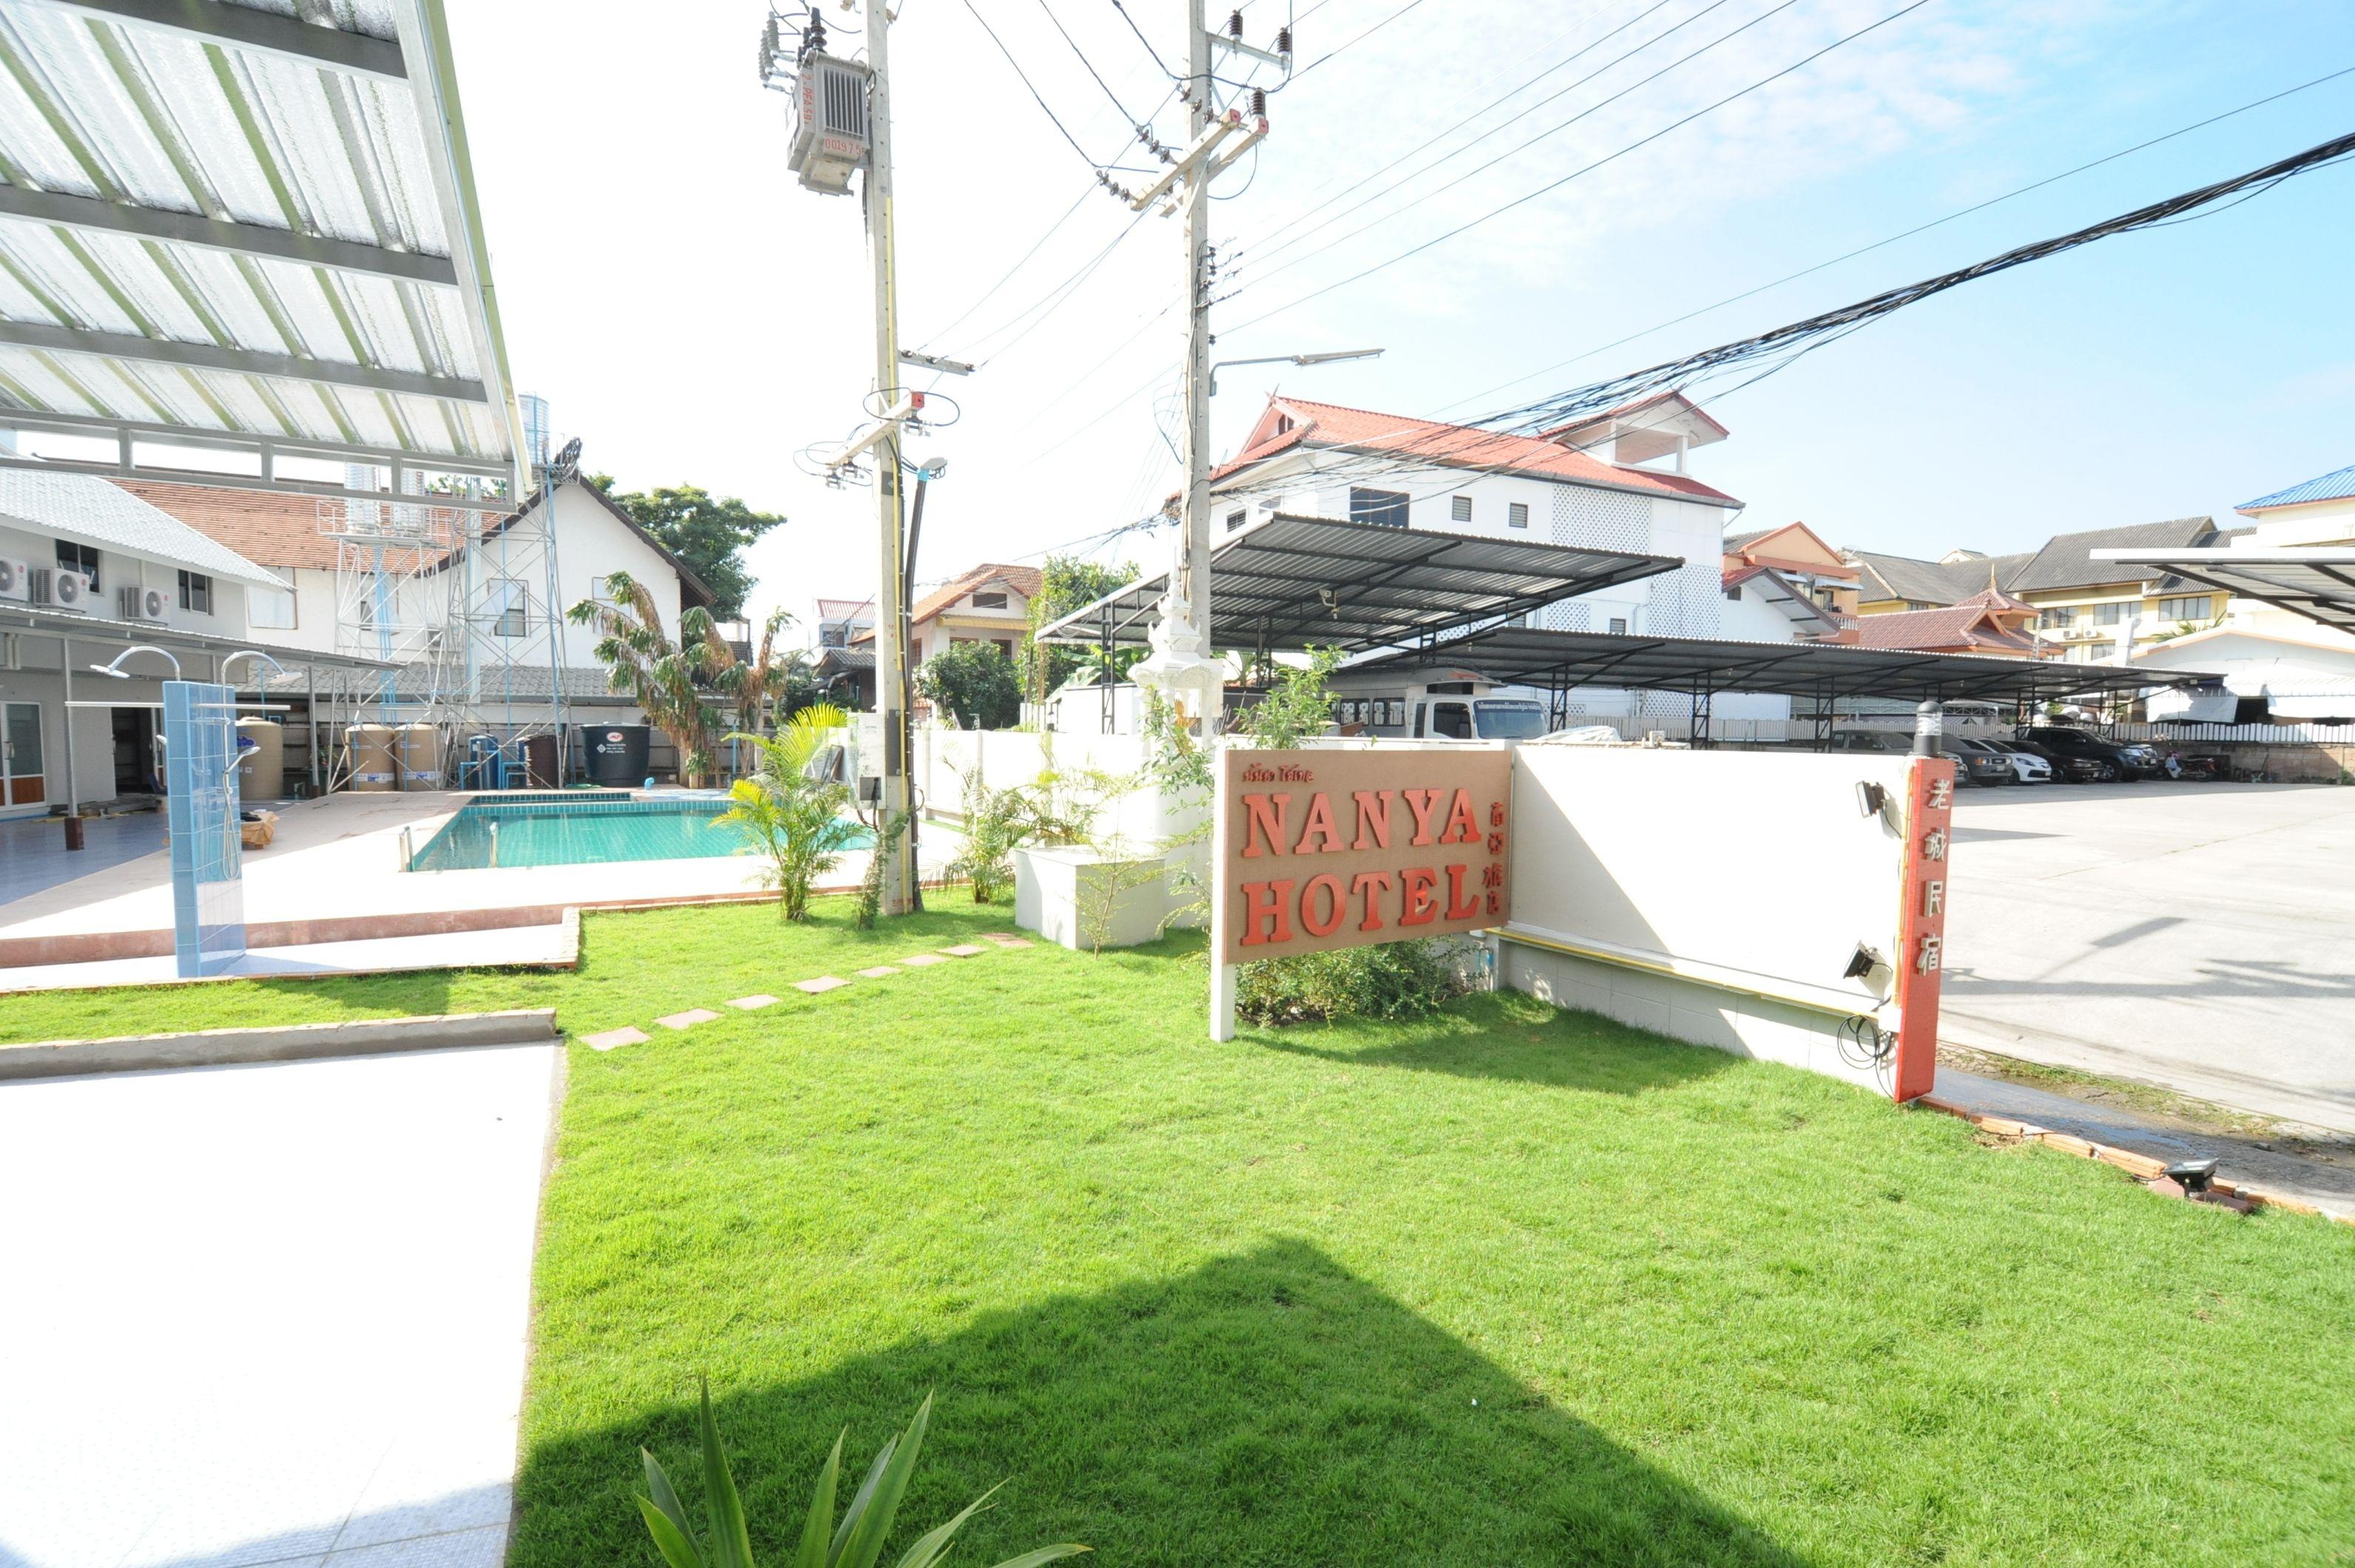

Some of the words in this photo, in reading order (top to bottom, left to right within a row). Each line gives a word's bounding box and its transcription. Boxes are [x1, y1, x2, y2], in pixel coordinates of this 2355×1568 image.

[1242, 788, 1481, 858] NANYA
[1241, 864, 1480, 946] HOTEL
[1917, 779, 1950, 976] 老城民宿
